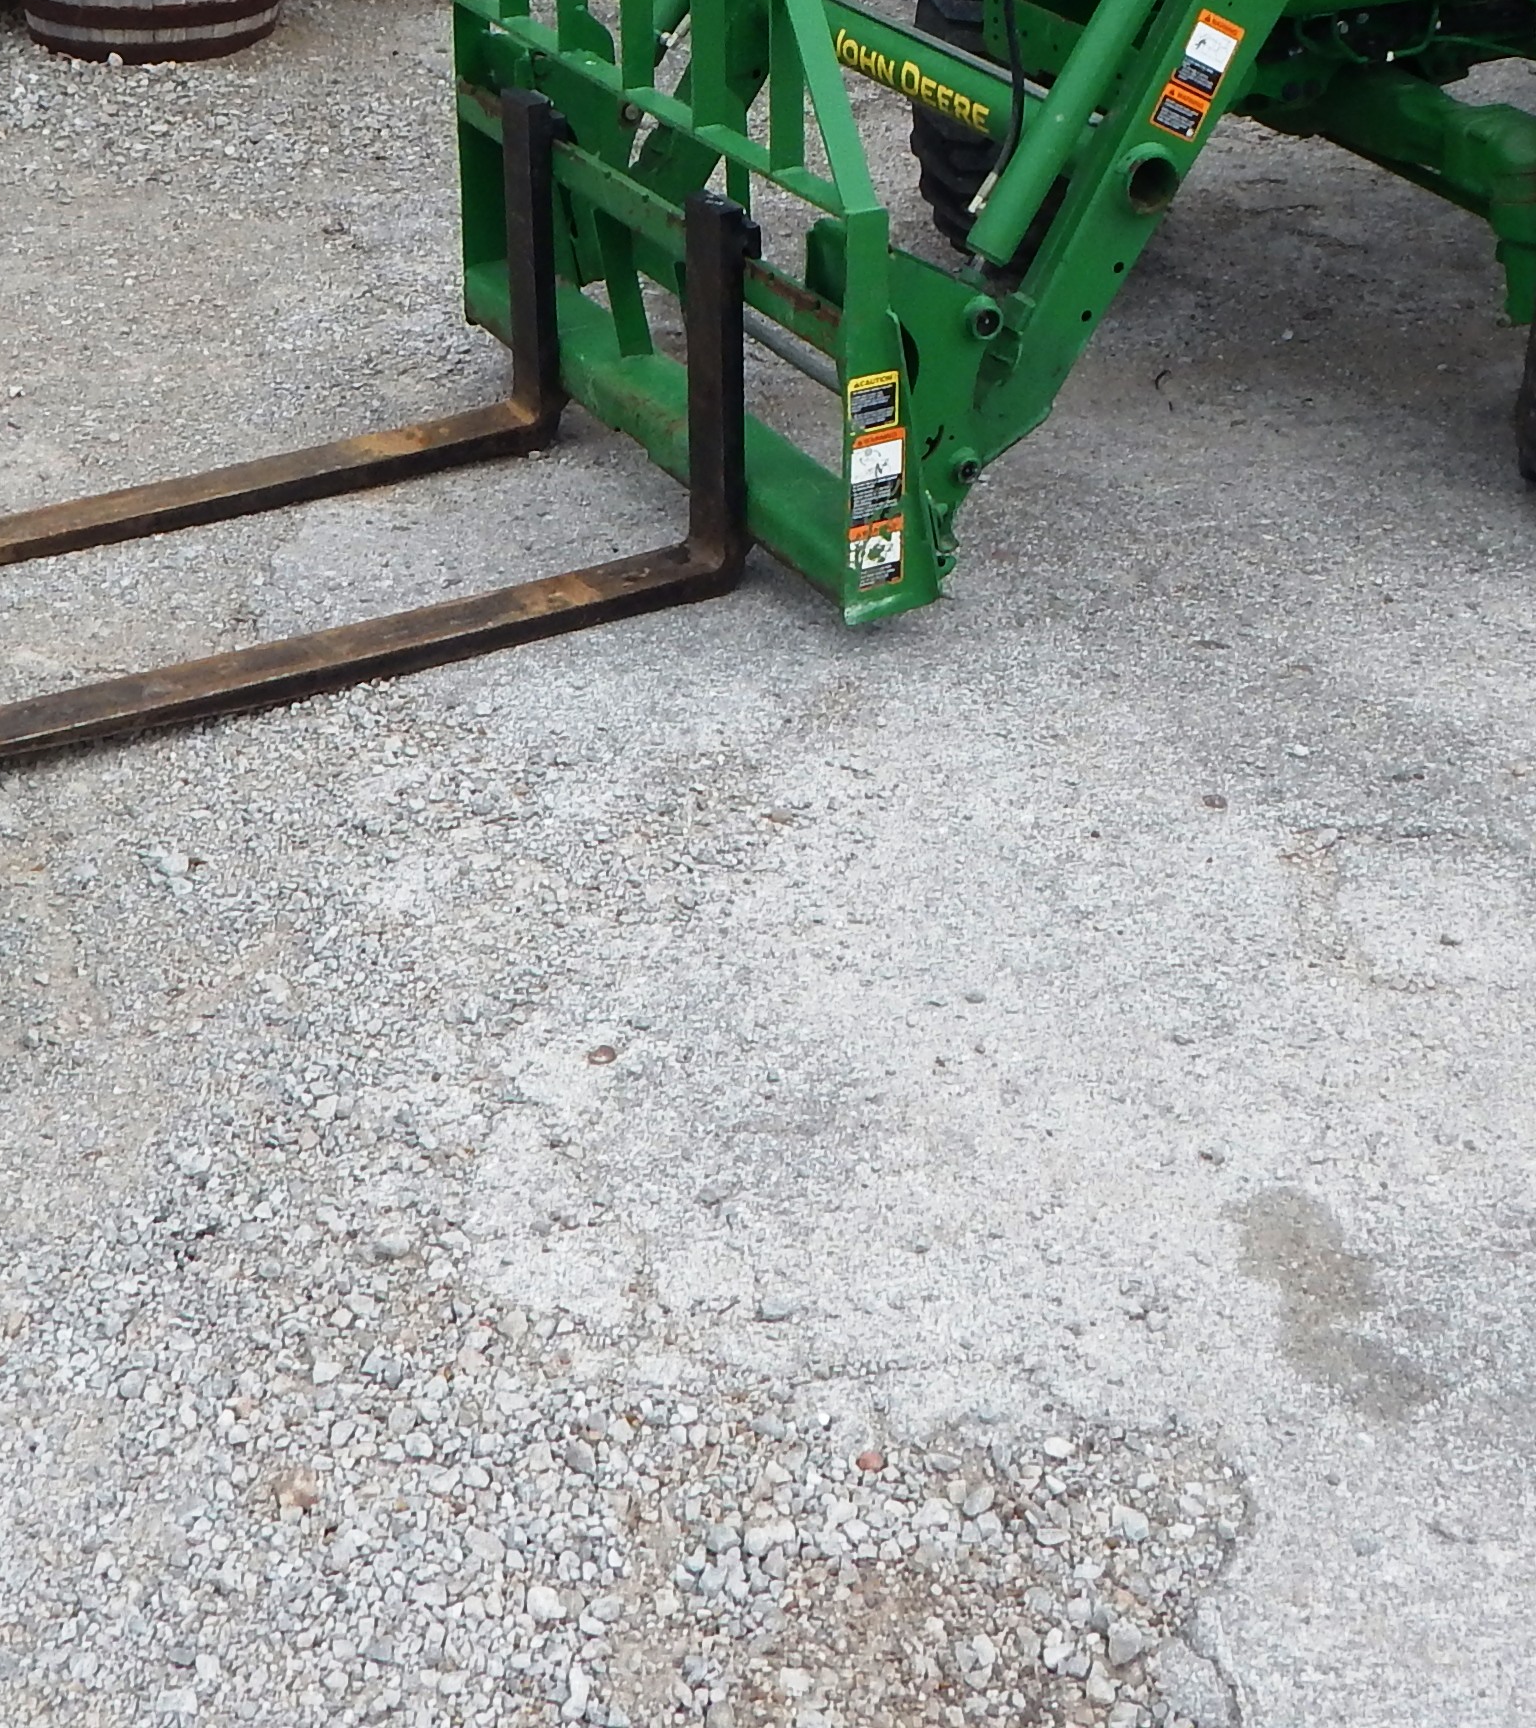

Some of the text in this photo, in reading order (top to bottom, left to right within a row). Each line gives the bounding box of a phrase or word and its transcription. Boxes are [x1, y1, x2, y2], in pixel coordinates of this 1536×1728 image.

[835, 28, 990, 135] JOHN DEERE
[859, 374, 894, 387] CAUTION
